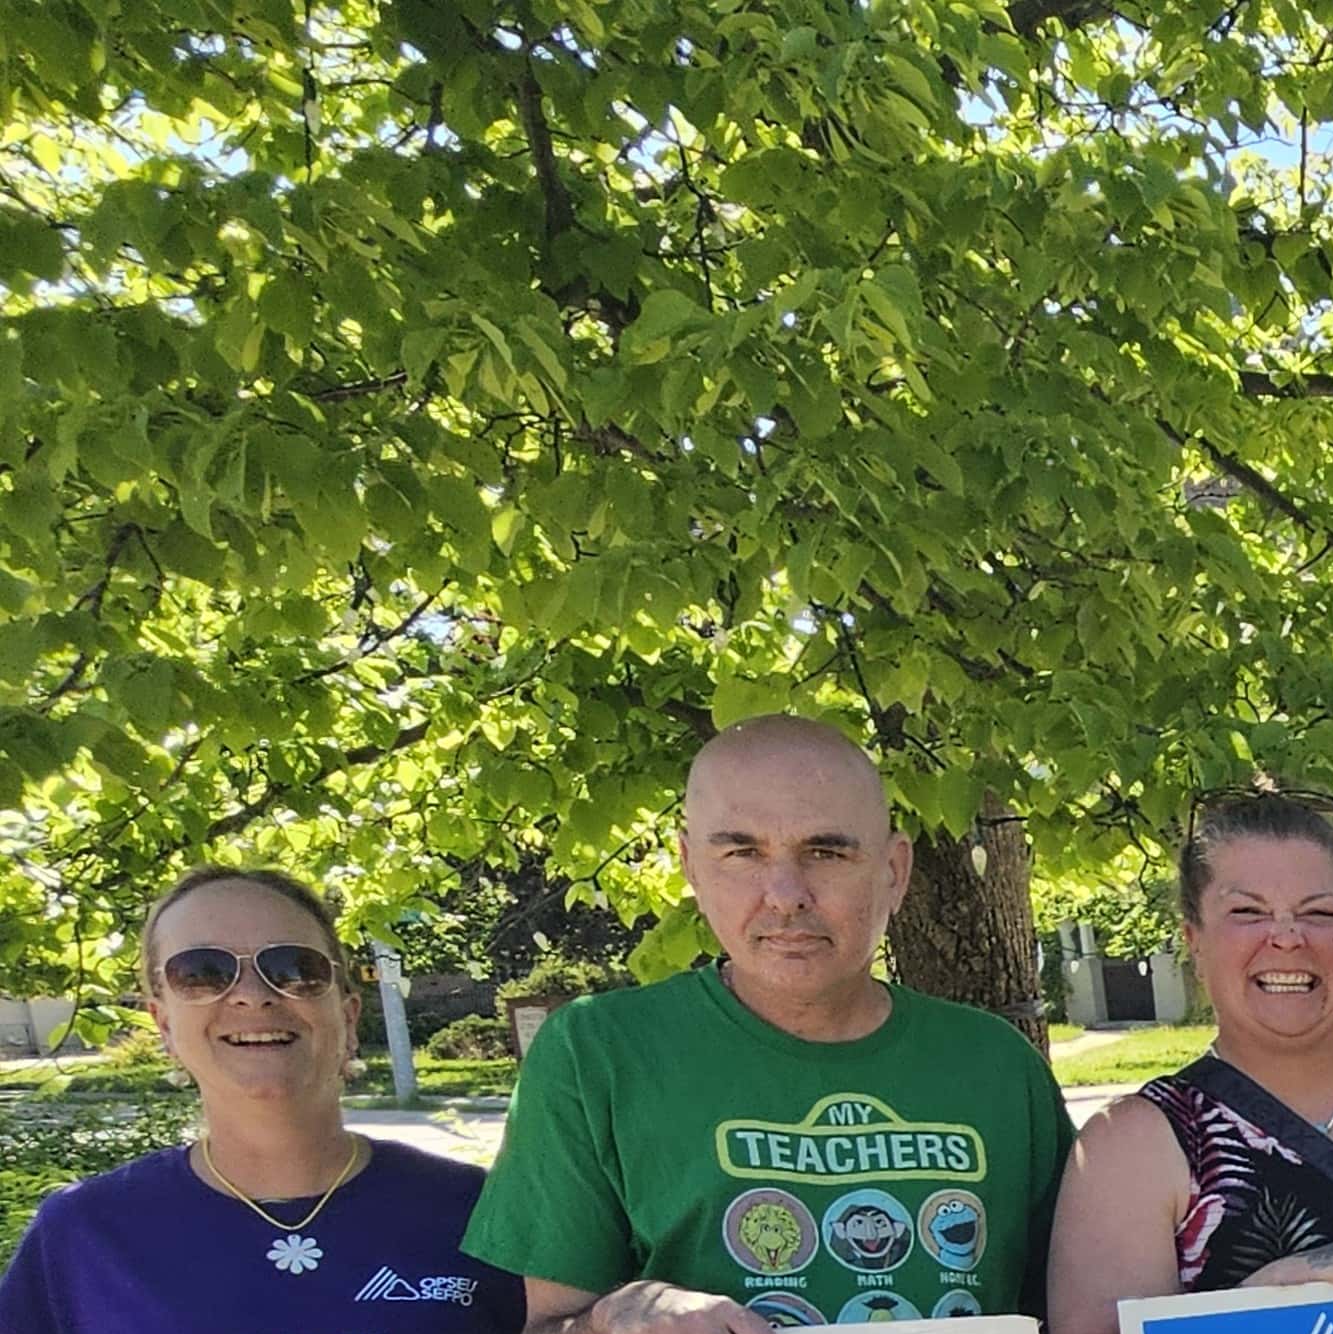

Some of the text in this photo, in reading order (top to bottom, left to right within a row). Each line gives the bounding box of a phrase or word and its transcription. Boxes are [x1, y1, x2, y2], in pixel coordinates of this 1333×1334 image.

[827, 1102, 872, 1126] MY
[735, 1131, 971, 1174] TEACHERS
[419, 1276, 478, 1294] OPSEU
